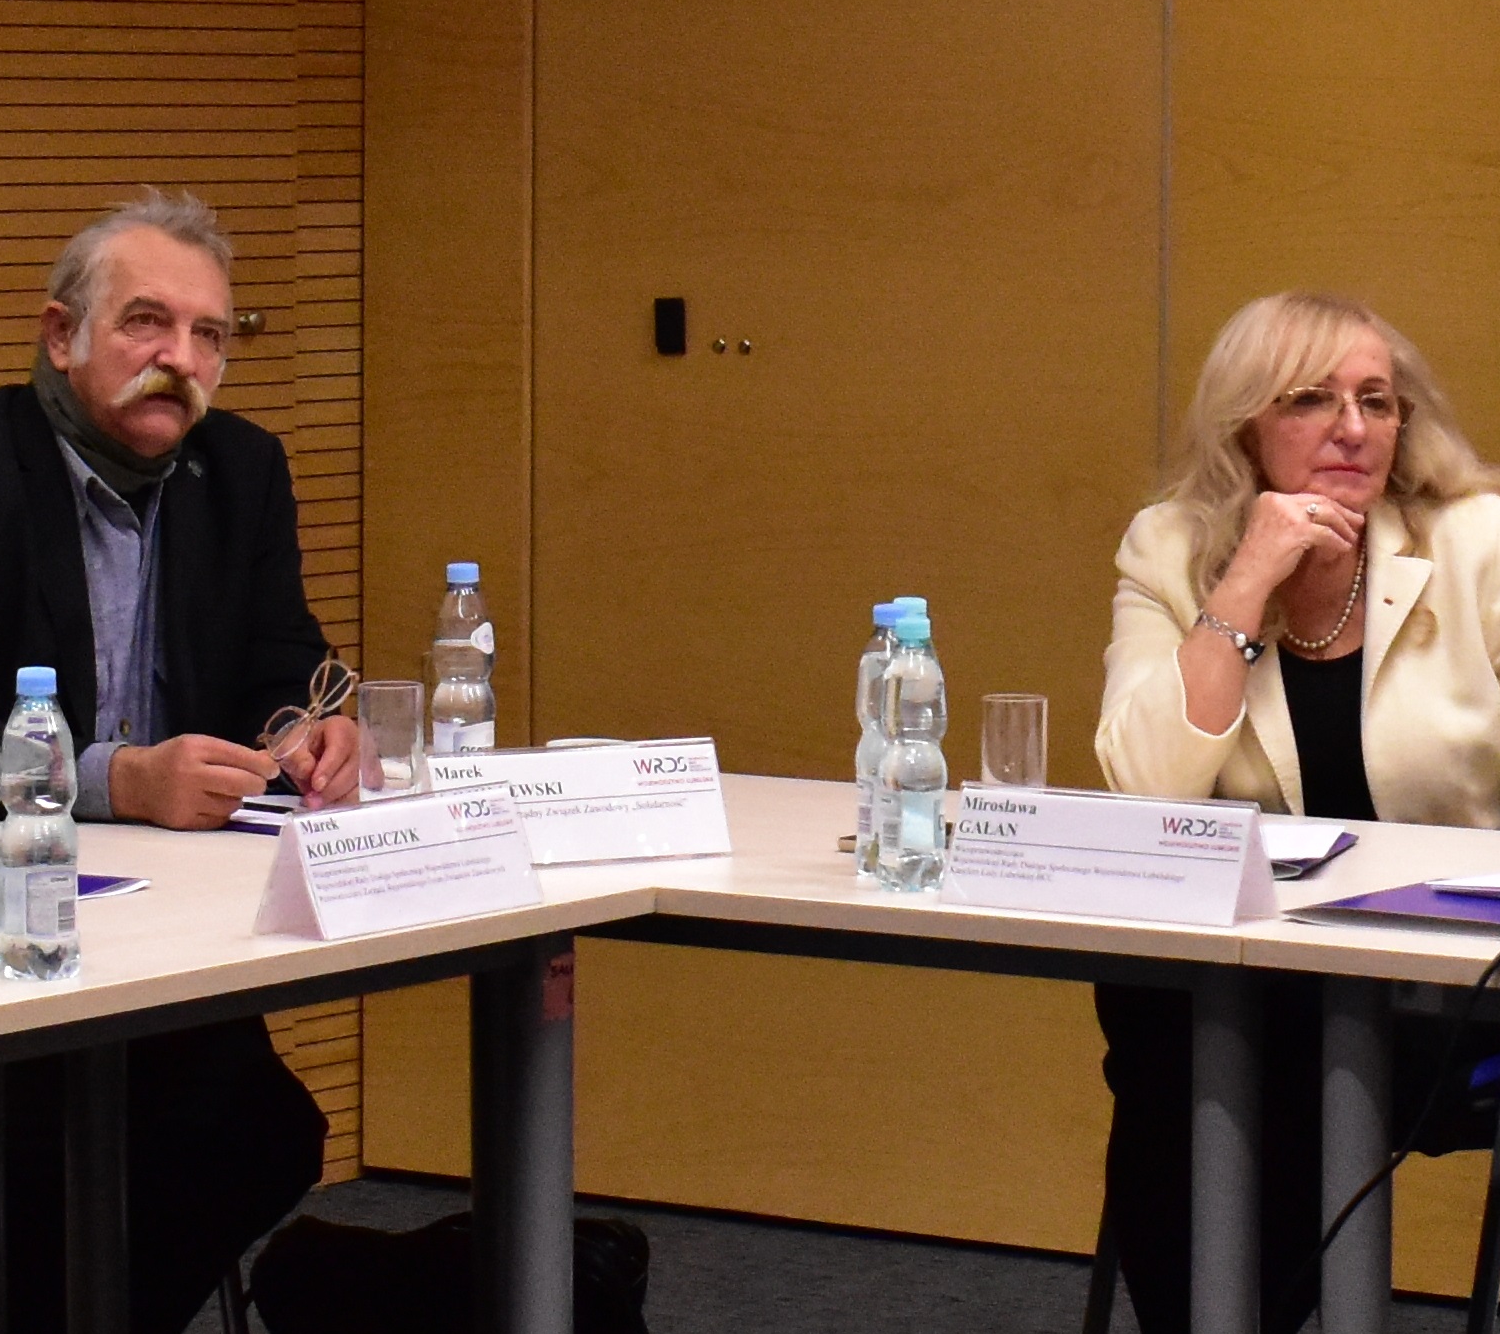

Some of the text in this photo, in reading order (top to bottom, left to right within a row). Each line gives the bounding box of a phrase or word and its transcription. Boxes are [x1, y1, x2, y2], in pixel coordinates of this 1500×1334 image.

[434, 764, 484, 780] Marek
[633, 756, 687, 774] WRDS
[300, 817, 340, 835] Marek
[1162, 816, 1218, 838] WRDS
